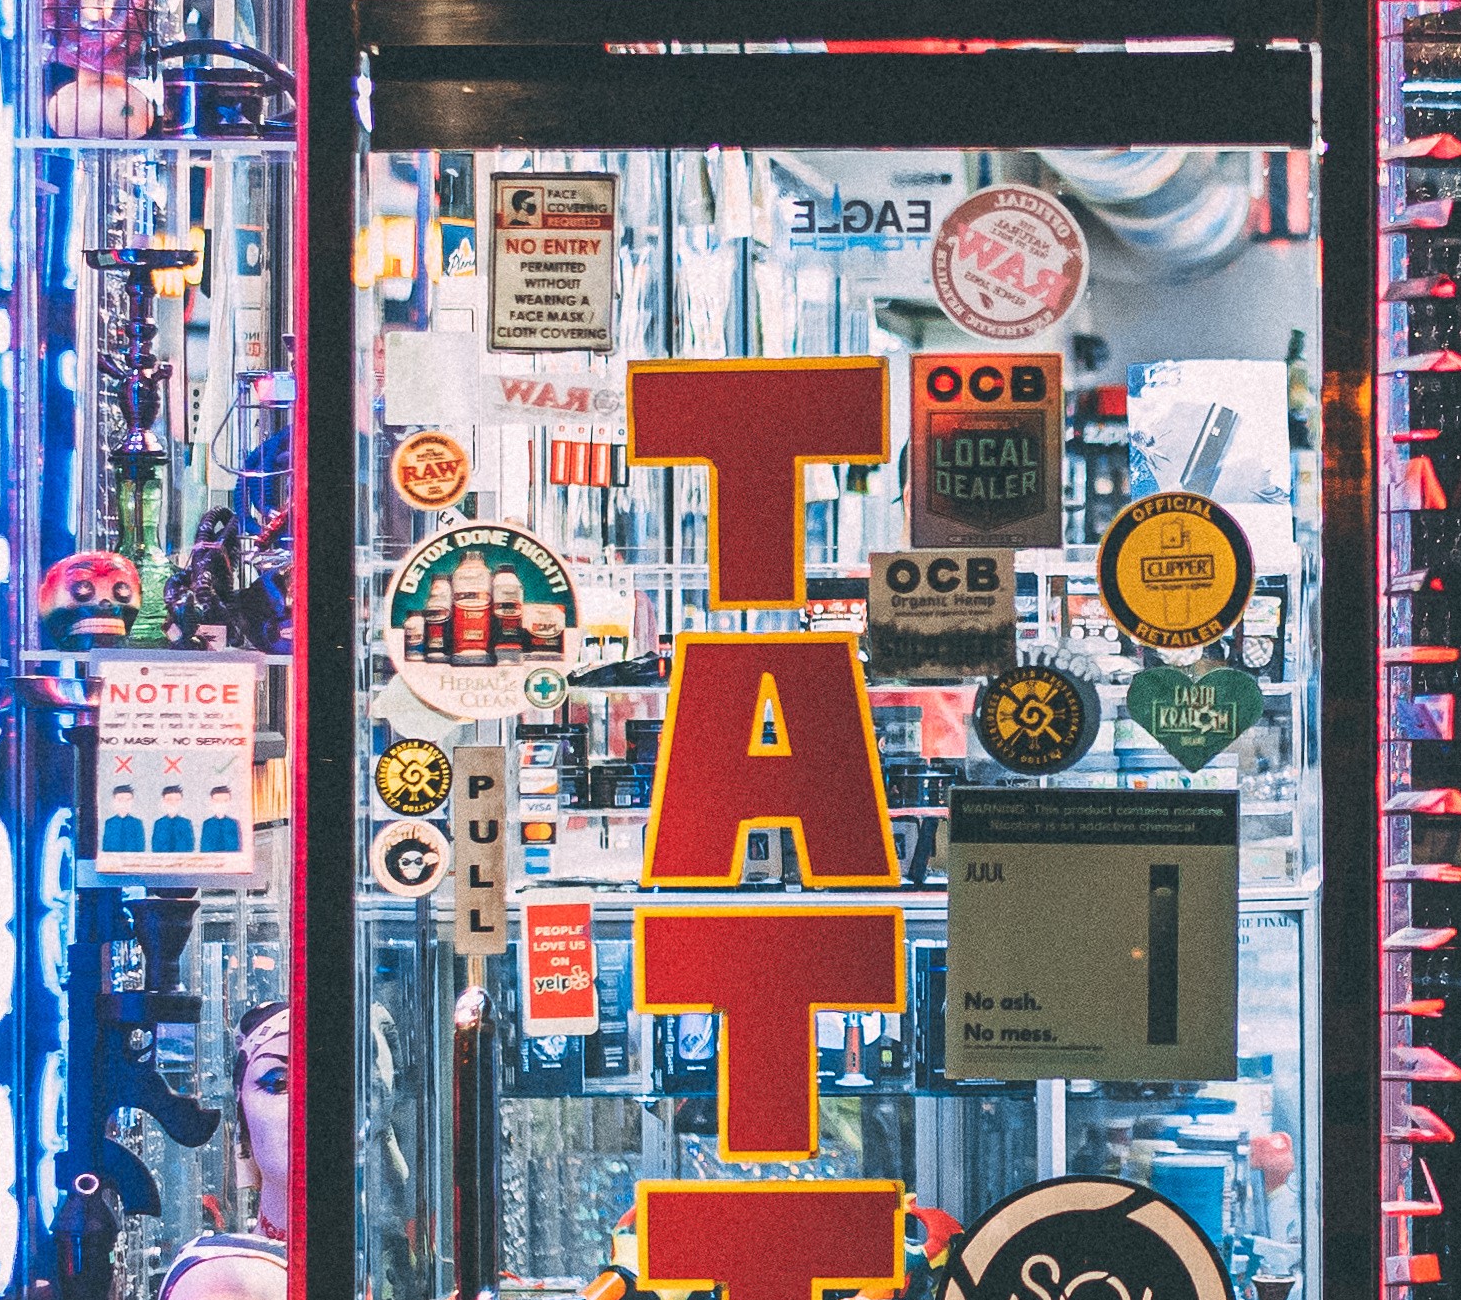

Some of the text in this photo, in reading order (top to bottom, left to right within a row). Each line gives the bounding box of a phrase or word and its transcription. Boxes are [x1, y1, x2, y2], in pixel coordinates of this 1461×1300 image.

[547, 189, 578, 199] FACE
[547, 203, 608, 213] COVERING
[505, 239, 601, 255] NO ENTRY
[520, 262, 586, 273] PERMITTED
[524, 278, 581, 289] WITHOUT
[514, 294, 590, 306] WEARING A
[509, 310, 543, 322] FACE
[547, 311, 585, 322] MASK
[497, 327, 608, 340] CLOTH COVERING
[926, 365, 1047, 402] OCB
[935, 437, 1038, 468] LOCAL
[402, 458, 465, 484] RAW
[935, 469, 1038, 500] DEALER
[1131, 494, 1214, 523] OFFICIAL
[399, 529, 569, 594] DETOX DONE RIGHT!
[1145, 559, 1211, 577] CLIPPER
[885, 557, 1001, 593] OCB
[891, 594, 997, 610] Organic Hemp
[1134, 619, 1225, 648] RETAILER
[109, 683, 240, 705] NOTICE
[99, 737, 119, 746] NO
[123, 737, 159, 746] MASK
[172, 737, 191, 746] NO
[195, 737, 248, 747] SERVICE
[527, 802, 552, 813] VISA
[468, 775, 499, 934] PULL
[963, 862, 1005, 884] JUUL
[534, 926, 584, 937] PEOPLE
[1255, 917, 1293, 929] FINAL
[533, 940, 586, 951] LOVE US
[550, 956, 570, 967] ON
[535, 976, 571, 995] yelp
[963, 991, 1043, 1011] No ash.
[963, 1023, 1059, 1043] No mess.
